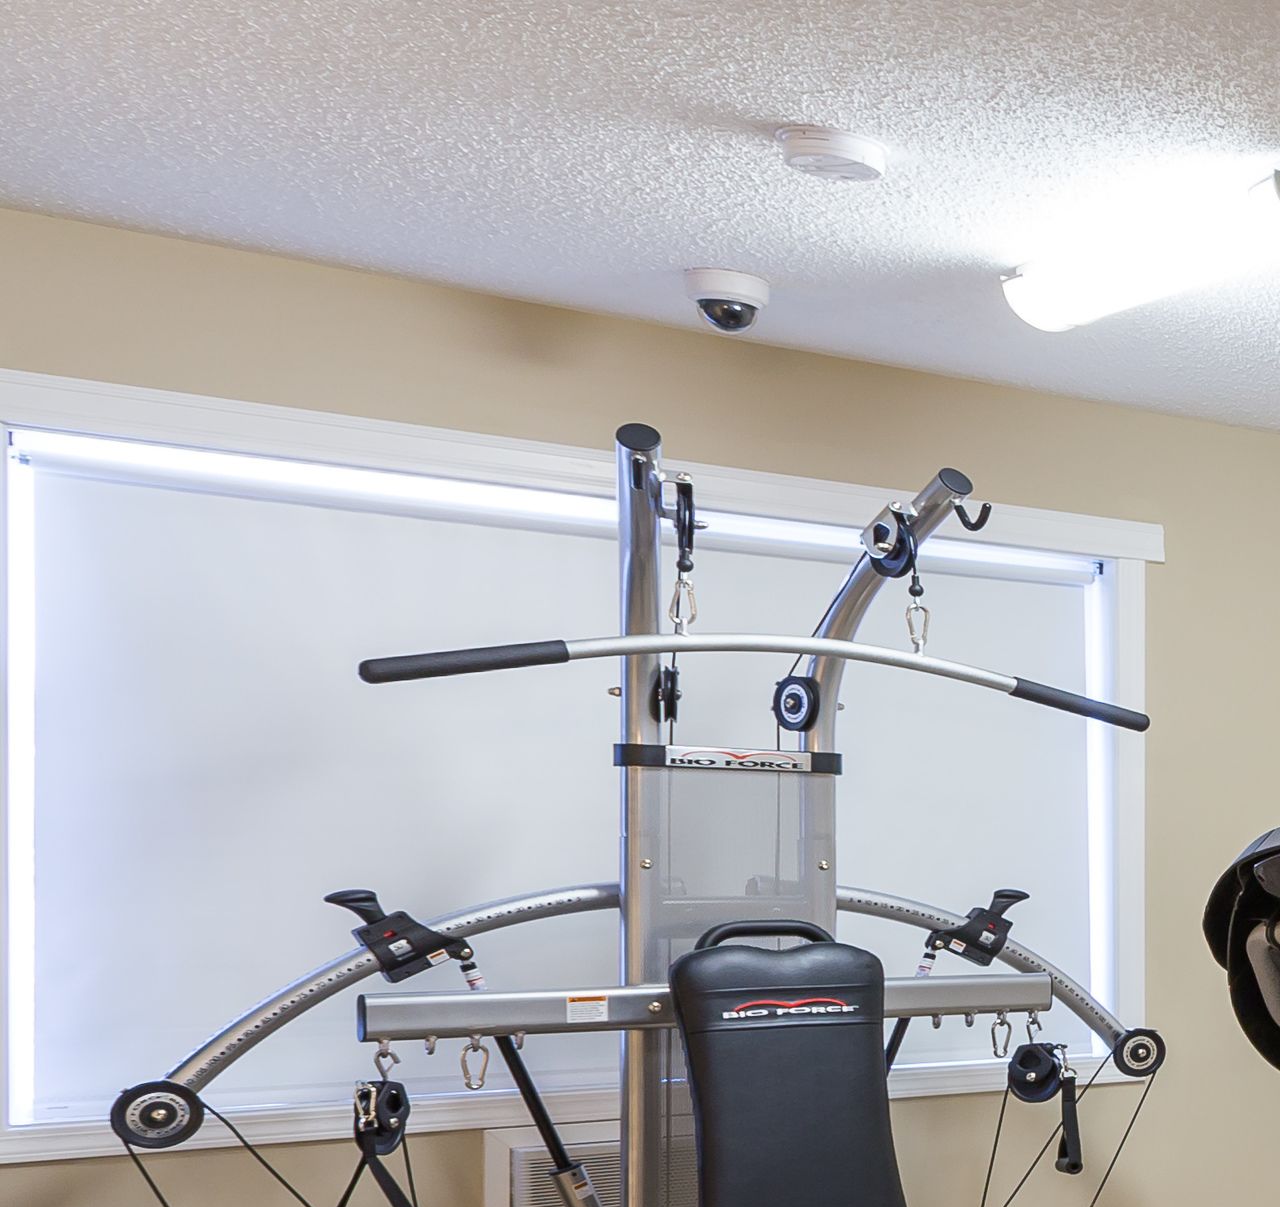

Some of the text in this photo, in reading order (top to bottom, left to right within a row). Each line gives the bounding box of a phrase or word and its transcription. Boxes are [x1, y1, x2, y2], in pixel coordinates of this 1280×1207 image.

[670, 757, 804, 770] BIO FORCE
[776, 1005, 859, 1016] FORCE
